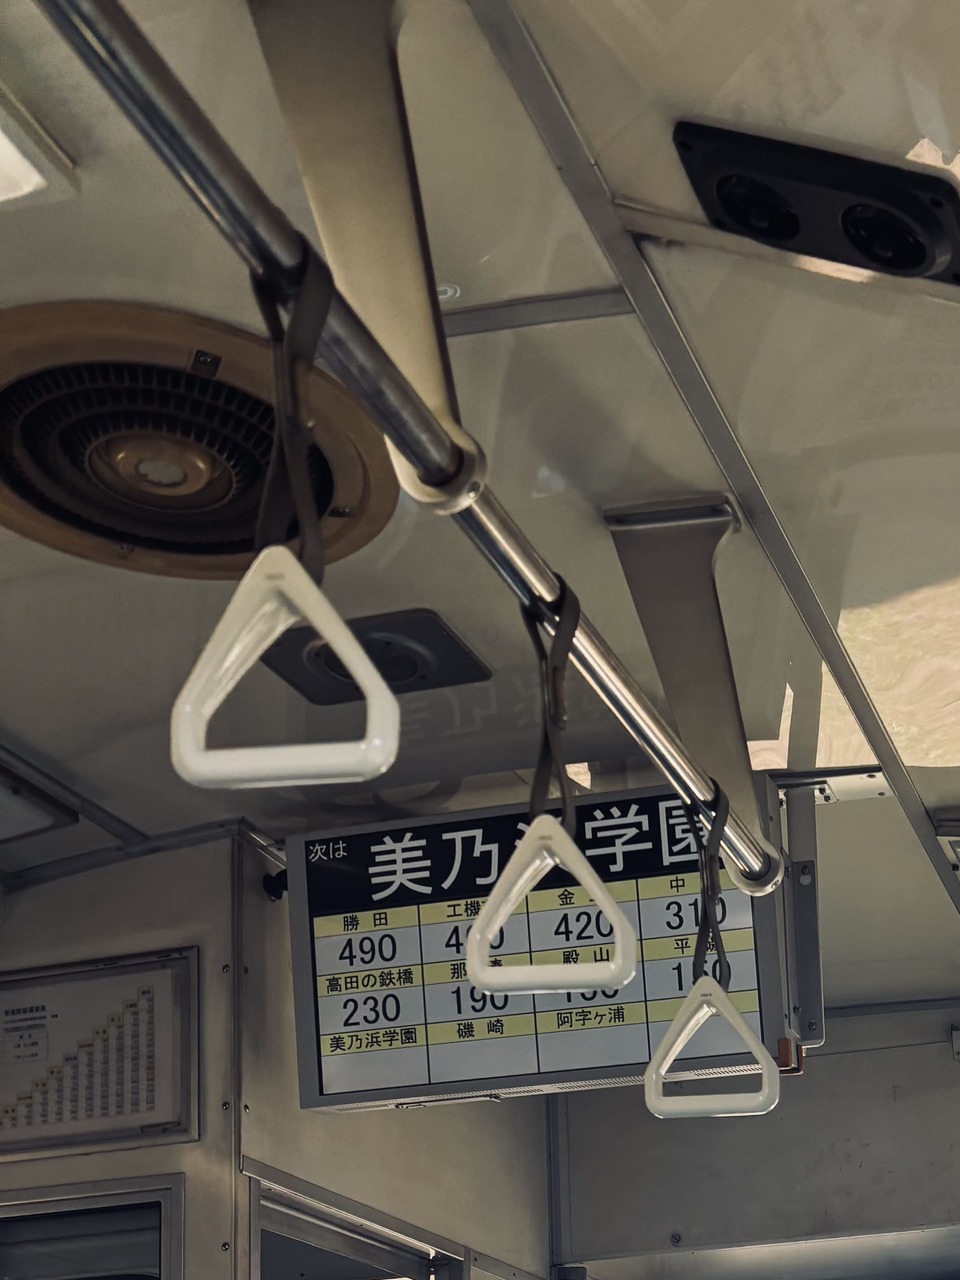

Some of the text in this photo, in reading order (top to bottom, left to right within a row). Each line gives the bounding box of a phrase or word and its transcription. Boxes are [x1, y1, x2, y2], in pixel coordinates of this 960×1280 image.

[309, 841, 347, 862] 次は
[368, 799, 713, 901] 美乃学園
[445, 924, 504, 953] 40
[554, 911, 613, 942] 420
[339, 933, 397, 967] 490
[326, 968, 414, 994] 高田の鉄橋
[343, 993, 400, 1027] 230
[451, 986, 508, 1014] 190
[329, 1027, 417, 1053] 美乃浜学園
